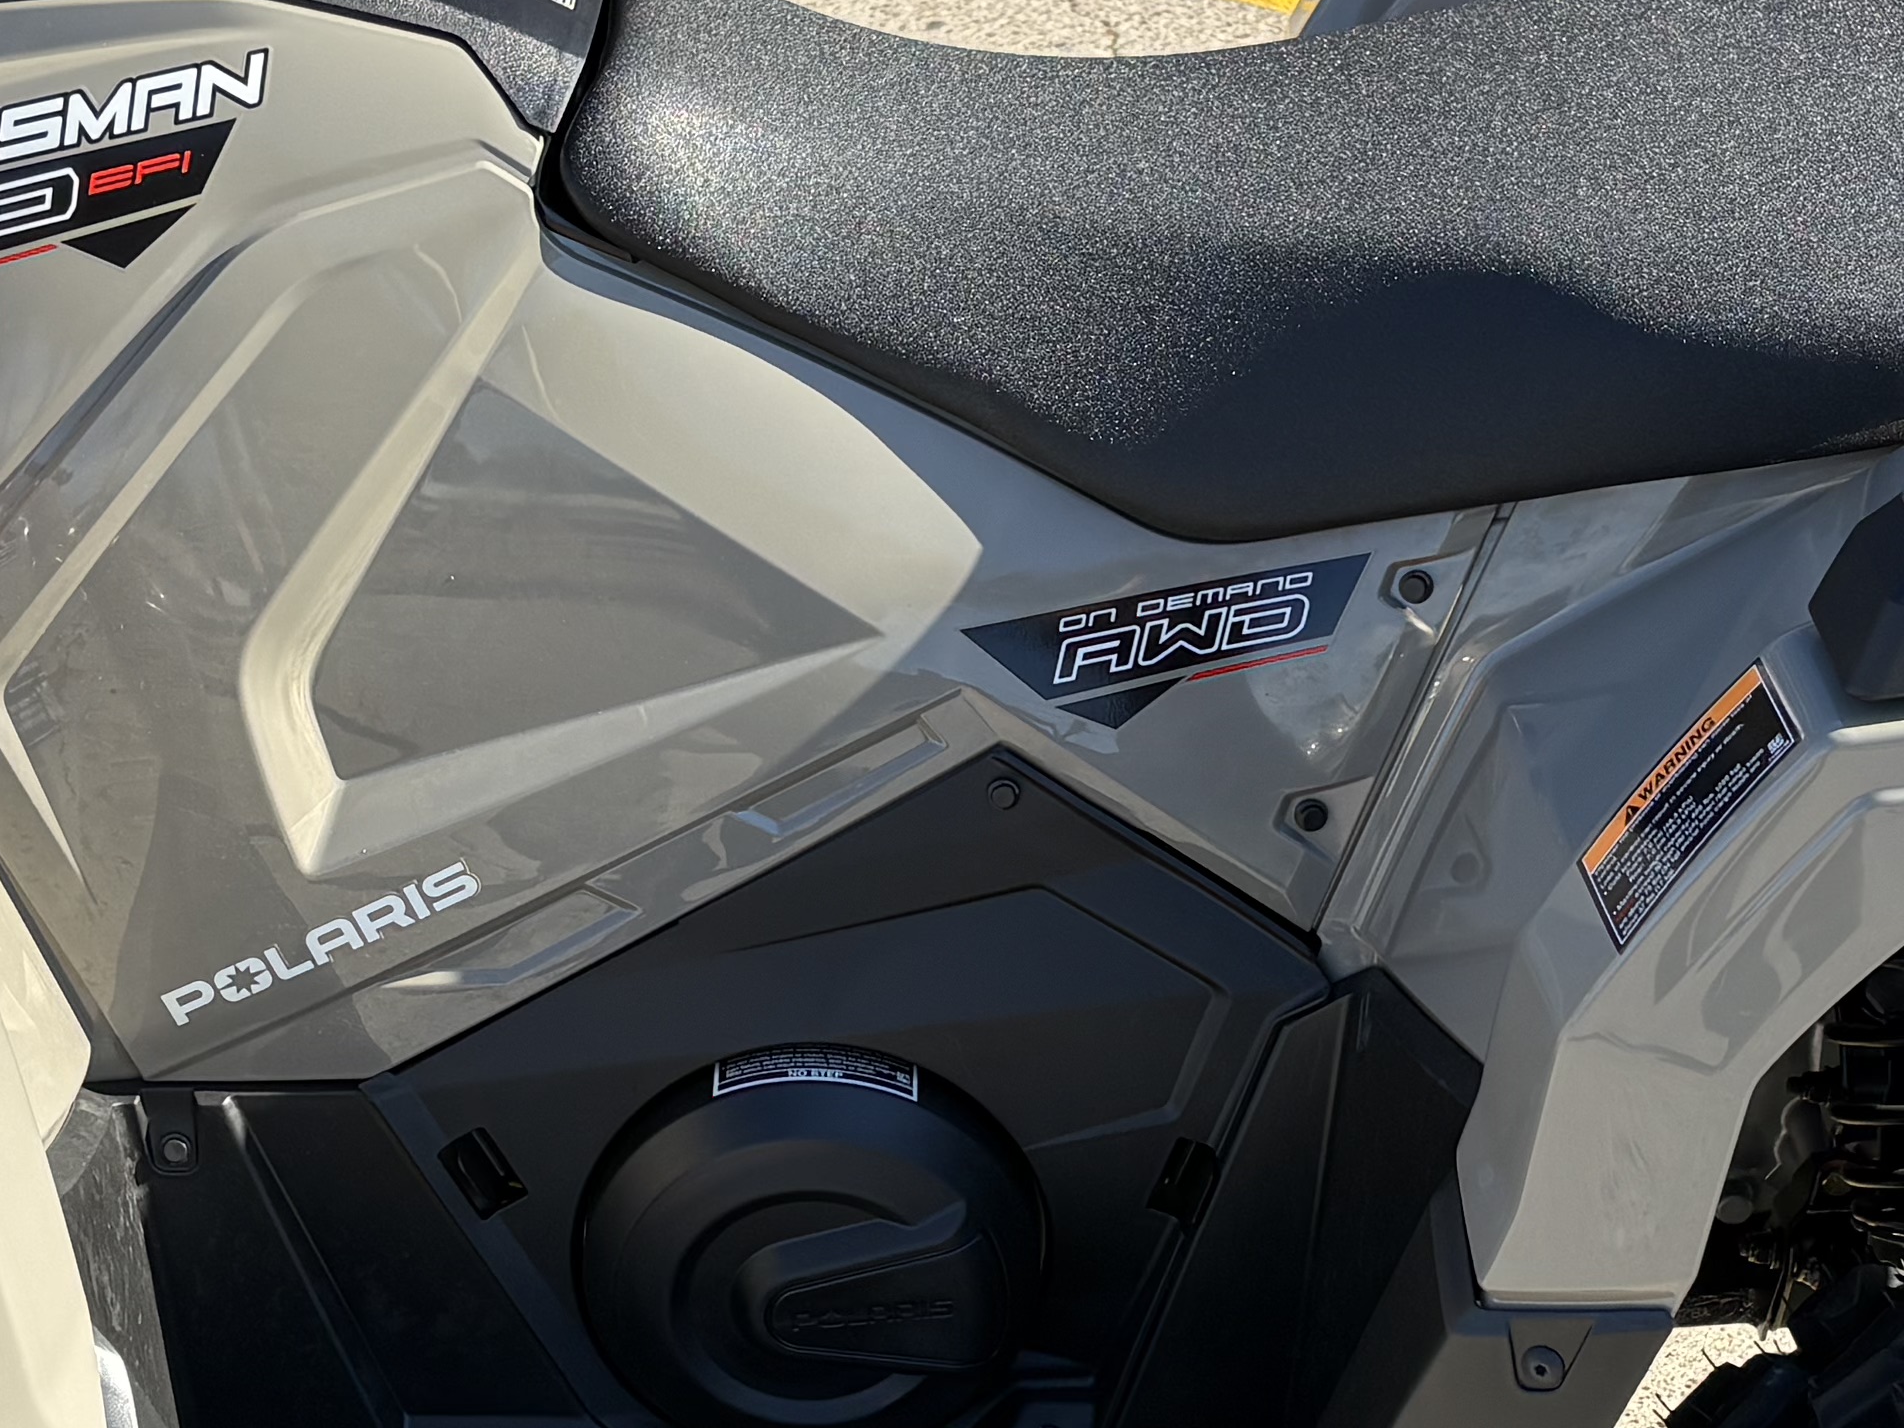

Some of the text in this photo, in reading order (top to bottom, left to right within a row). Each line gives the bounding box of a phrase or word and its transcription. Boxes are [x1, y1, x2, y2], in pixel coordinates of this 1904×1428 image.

[89, 150, 189, 197] EFI
[1052, 594, 1310, 685] AWD
[1059, 571, 1313, 633] ON DEMAND
[1637, 715, 1716, 803] WARNING
[160, 857, 482, 1027] POLARIS
[790, 1298, 957, 1332] POLARIS
